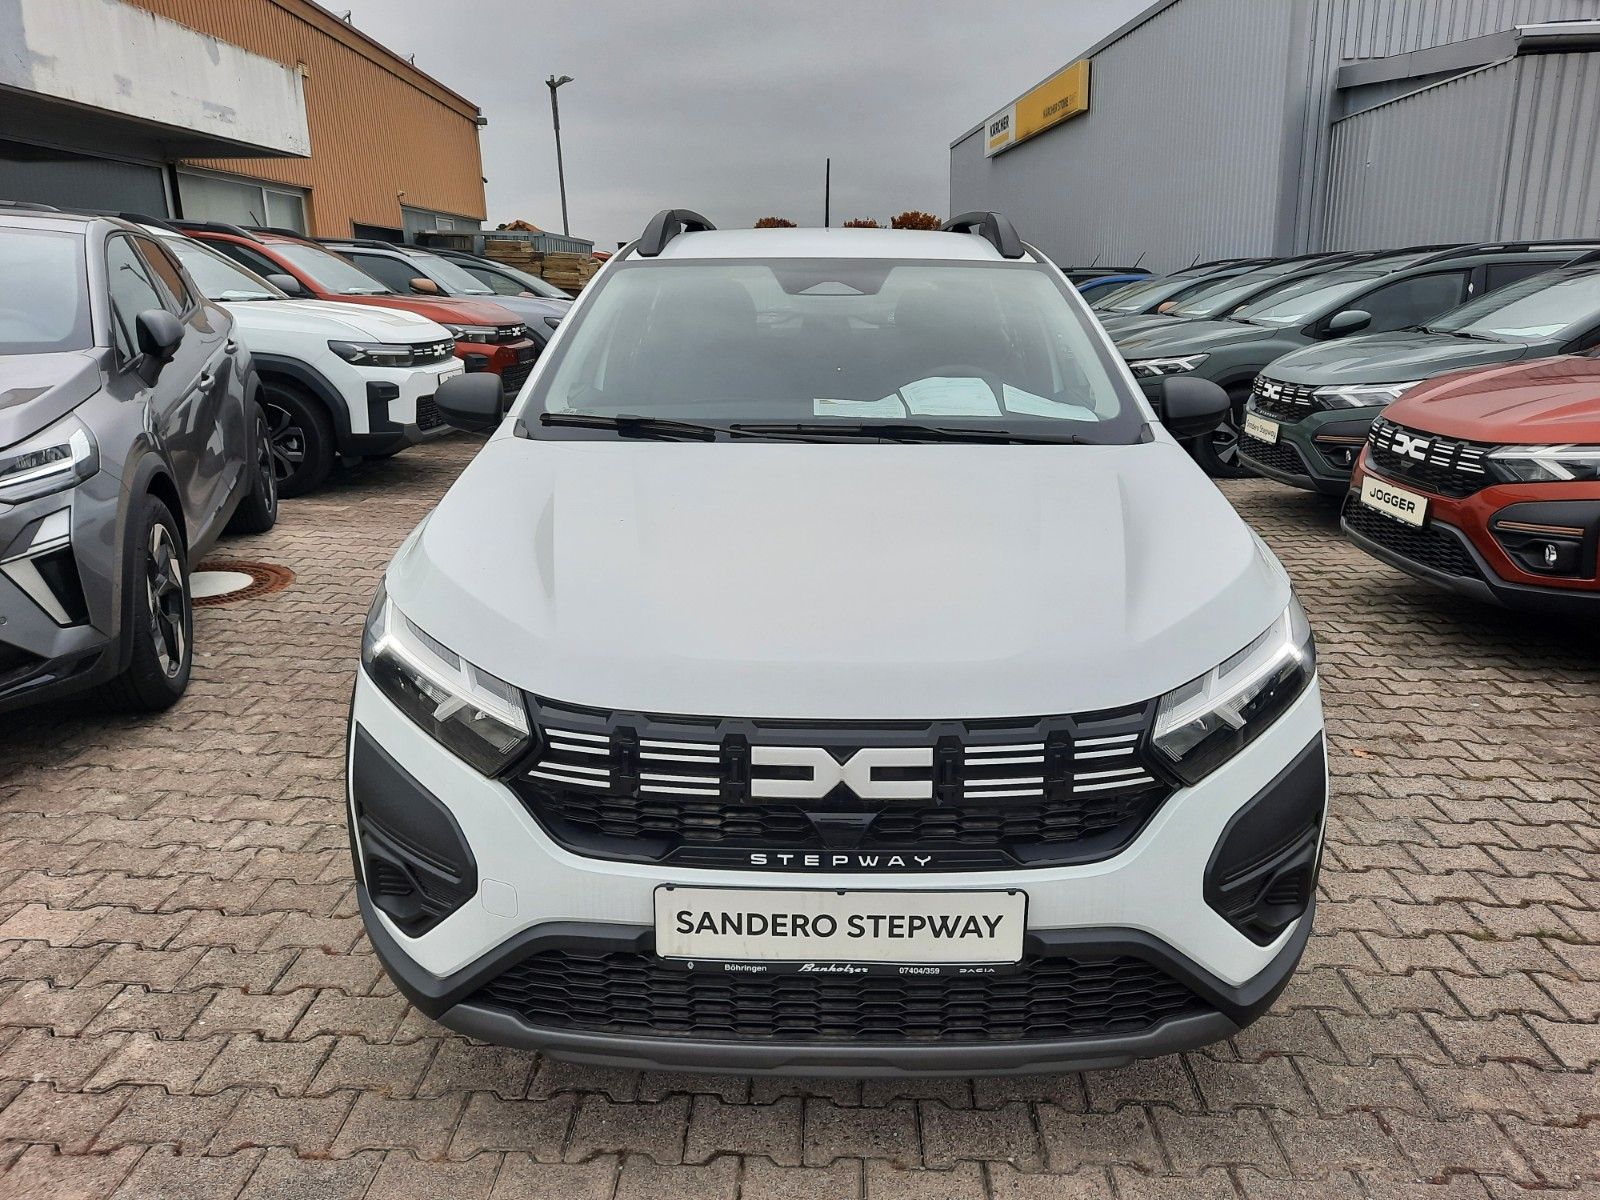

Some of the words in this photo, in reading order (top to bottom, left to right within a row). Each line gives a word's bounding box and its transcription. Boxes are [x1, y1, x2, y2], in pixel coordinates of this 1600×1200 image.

[1369, 487, 1416, 514] JOGGER
[750, 853, 932, 867] STEPWAY
[675, 910, 838, 938] SANDERO
[847, 914, 1004, 939] STEPWAY
[724, 963, 767, 973] Böhringen
[798, 963, 869, 974] Banholzer
[899, 967, 940, 975] 07404/359
